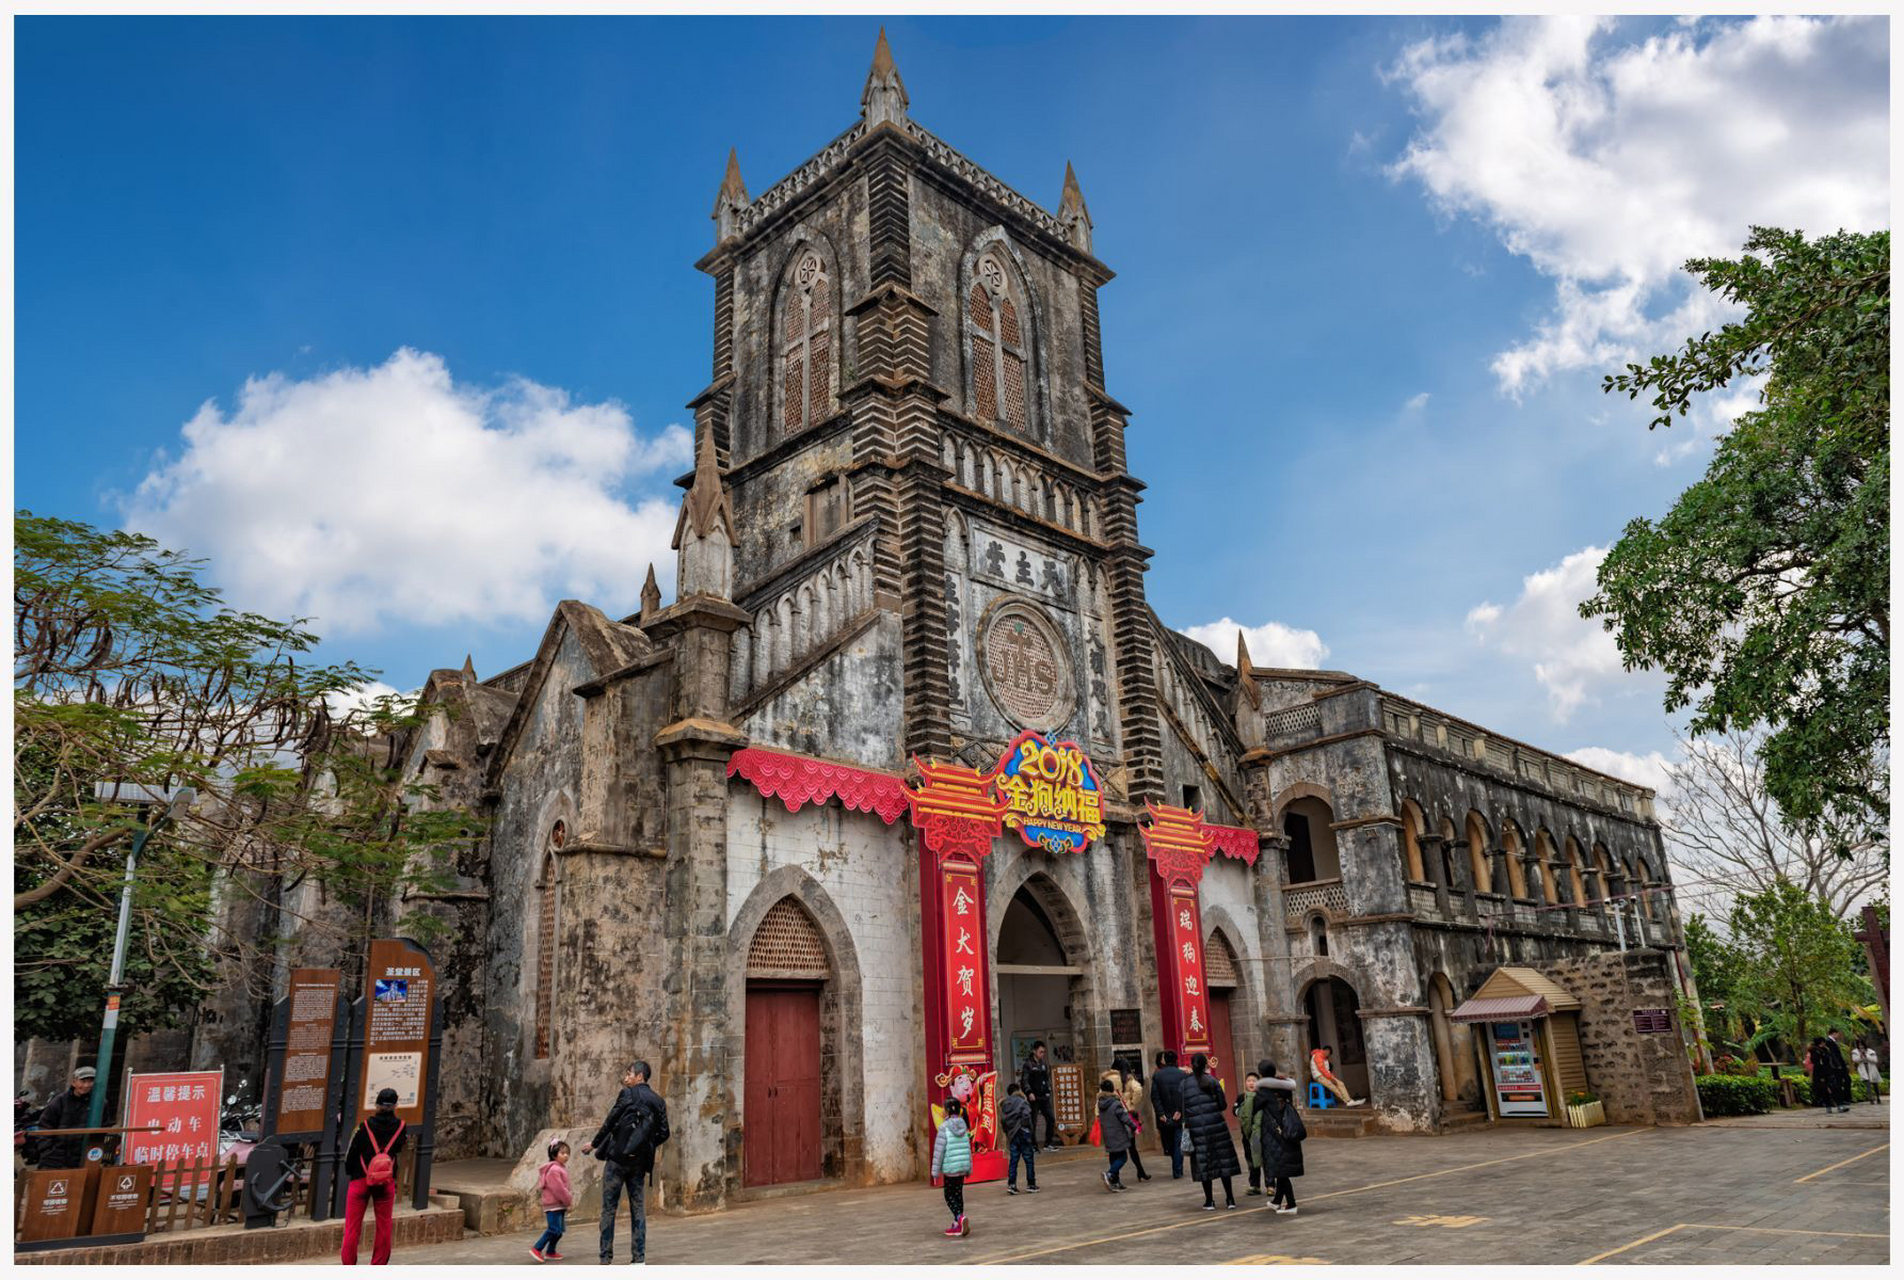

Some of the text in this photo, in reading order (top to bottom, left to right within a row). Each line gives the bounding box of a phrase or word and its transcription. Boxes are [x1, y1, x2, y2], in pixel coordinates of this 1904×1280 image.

[1018, 740, 1084, 786] 2018
[996, 773, 1101, 824] 金狗纳福
[1023, 816, 1083, 834] HAPPY NEW YEAR
[952, 886, 975, 1040] 金犬贺岁
[1179, 908, 1204, 1034] 瑞狗迎春
[146, 1085, 206, 1103] 温馨提示
[147, 1115, 202, 1136] 电动车
[133, 1142, 210, 1164] 临时停车点
